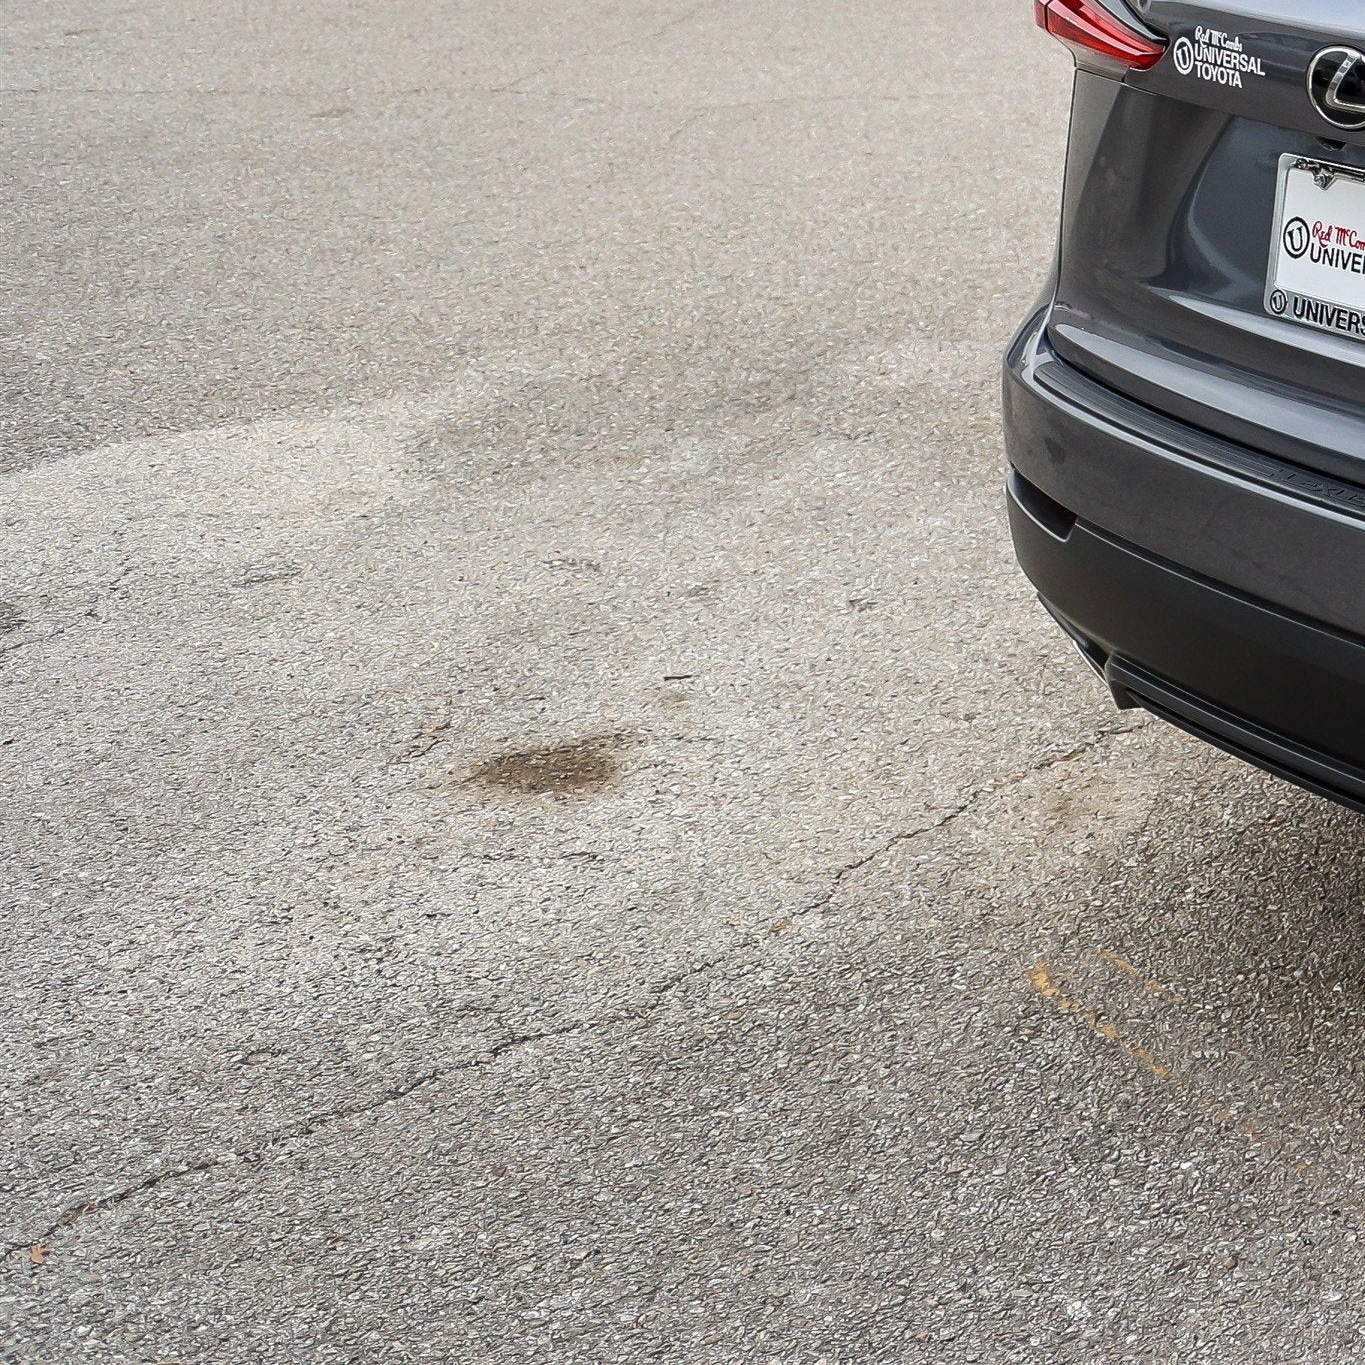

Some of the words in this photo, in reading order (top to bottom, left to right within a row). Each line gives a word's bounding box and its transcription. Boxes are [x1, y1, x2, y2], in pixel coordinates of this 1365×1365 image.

[1195, 25, 1210, 47] Red
[1194, 43, 1266, 76] UNIVERSAL
[1194, 61, 1243, 88] TOYOTA
[1312, 220, 1333, 249] Red
